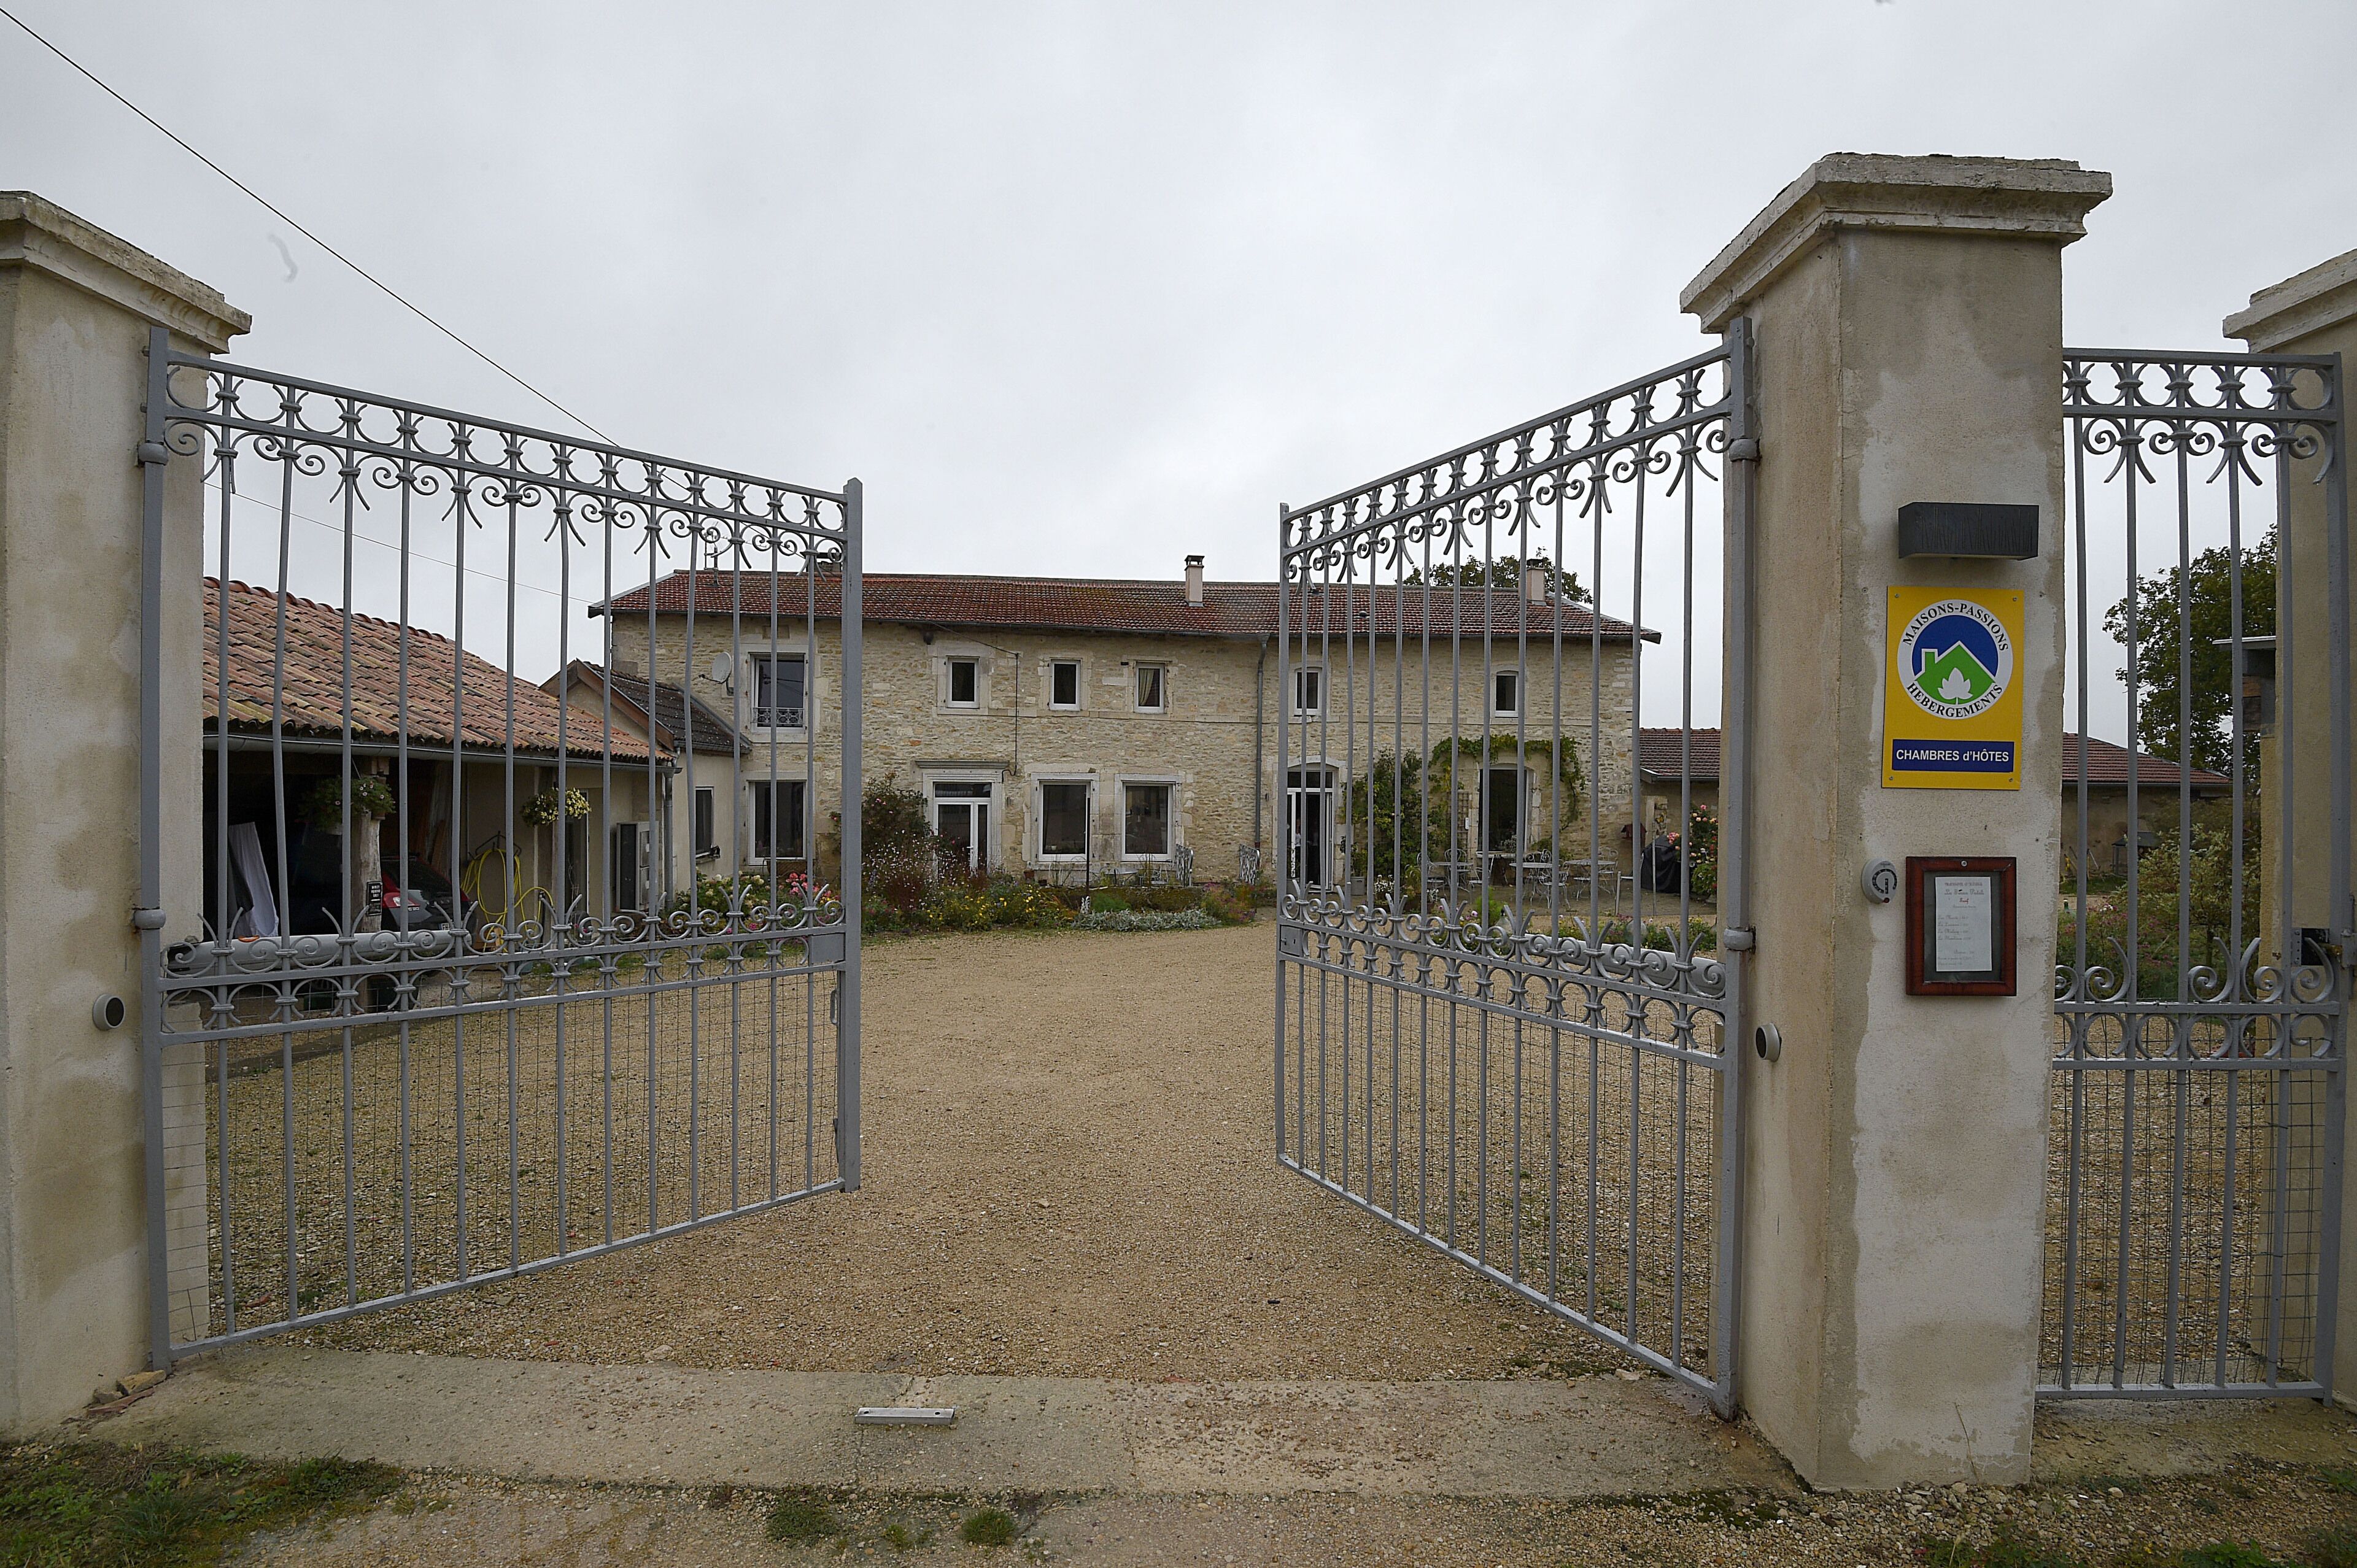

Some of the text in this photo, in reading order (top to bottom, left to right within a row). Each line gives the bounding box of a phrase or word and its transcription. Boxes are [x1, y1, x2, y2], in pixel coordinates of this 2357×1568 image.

[1903, 603, 2008, 651] MAISONS-PASSIONS
[1907, 682, 2003, 717] HEBERGEMENTS
[1896, 749, 2009, 762] CHAMBRES d'HÔTES
